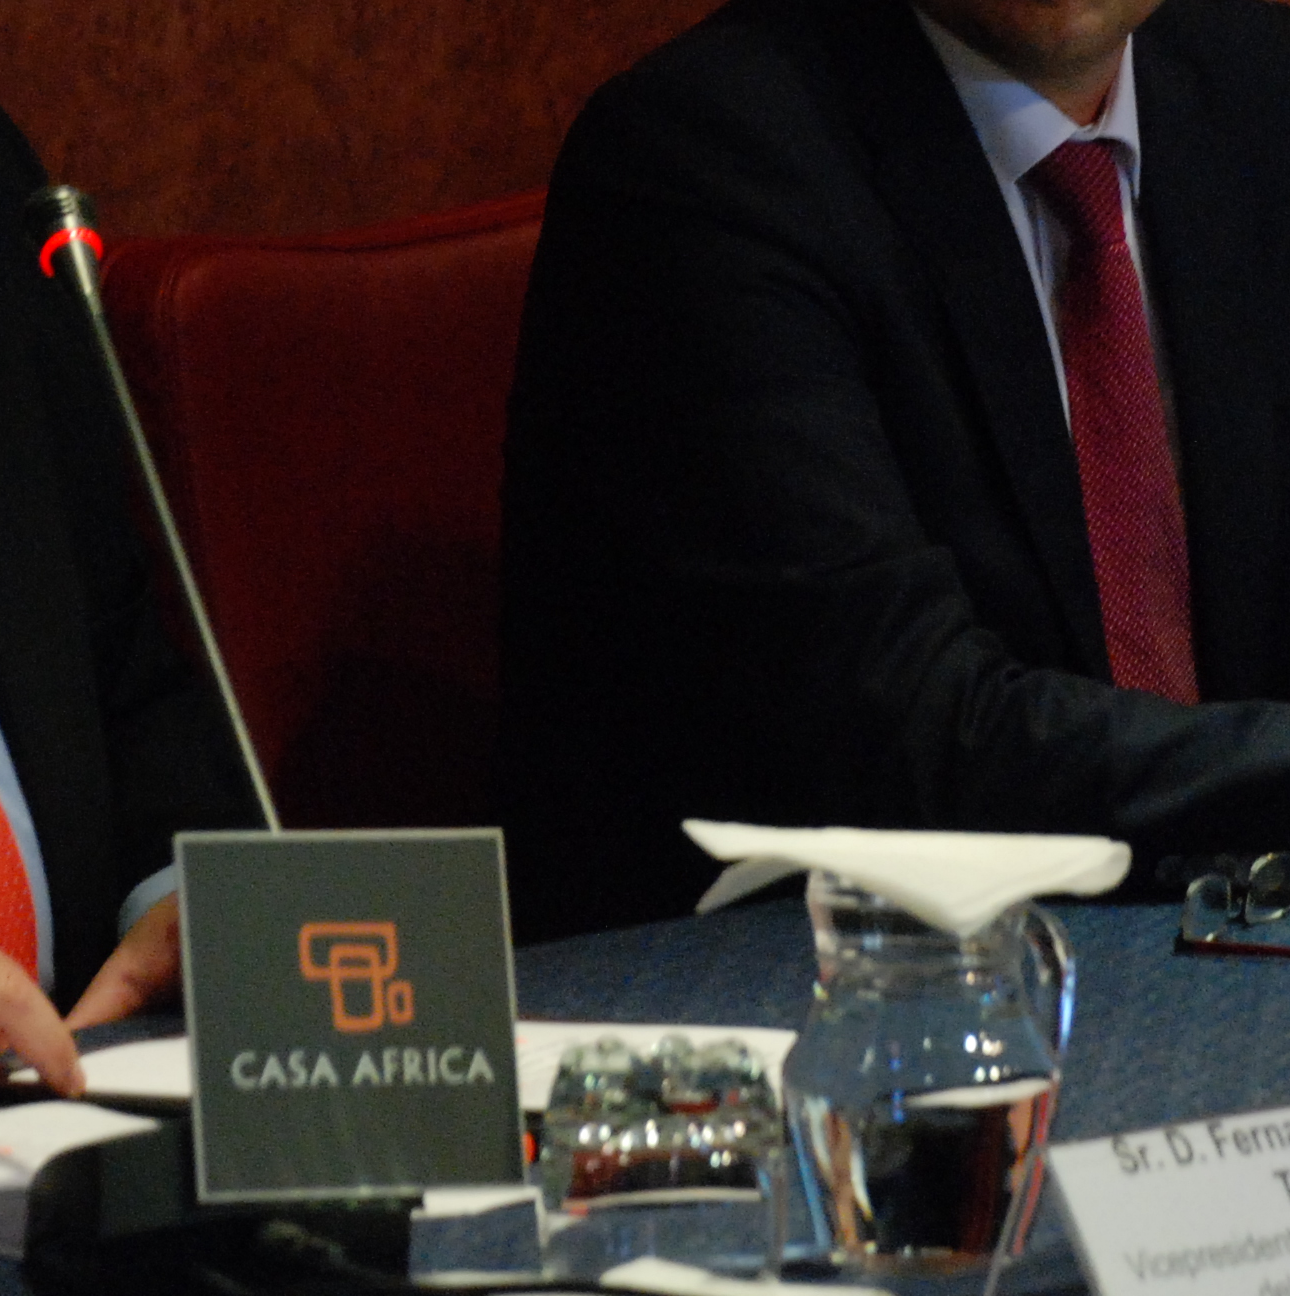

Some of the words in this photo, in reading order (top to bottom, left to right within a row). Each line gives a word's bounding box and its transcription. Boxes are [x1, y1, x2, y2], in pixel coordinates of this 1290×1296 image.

[231, 1049, 344, 1090] CASA
[352, 1045, 496, 1087] AFRICA
[1111, 1134, 1165, 1174] Sr.
[1163, 1126, 1207, 1166] D.
